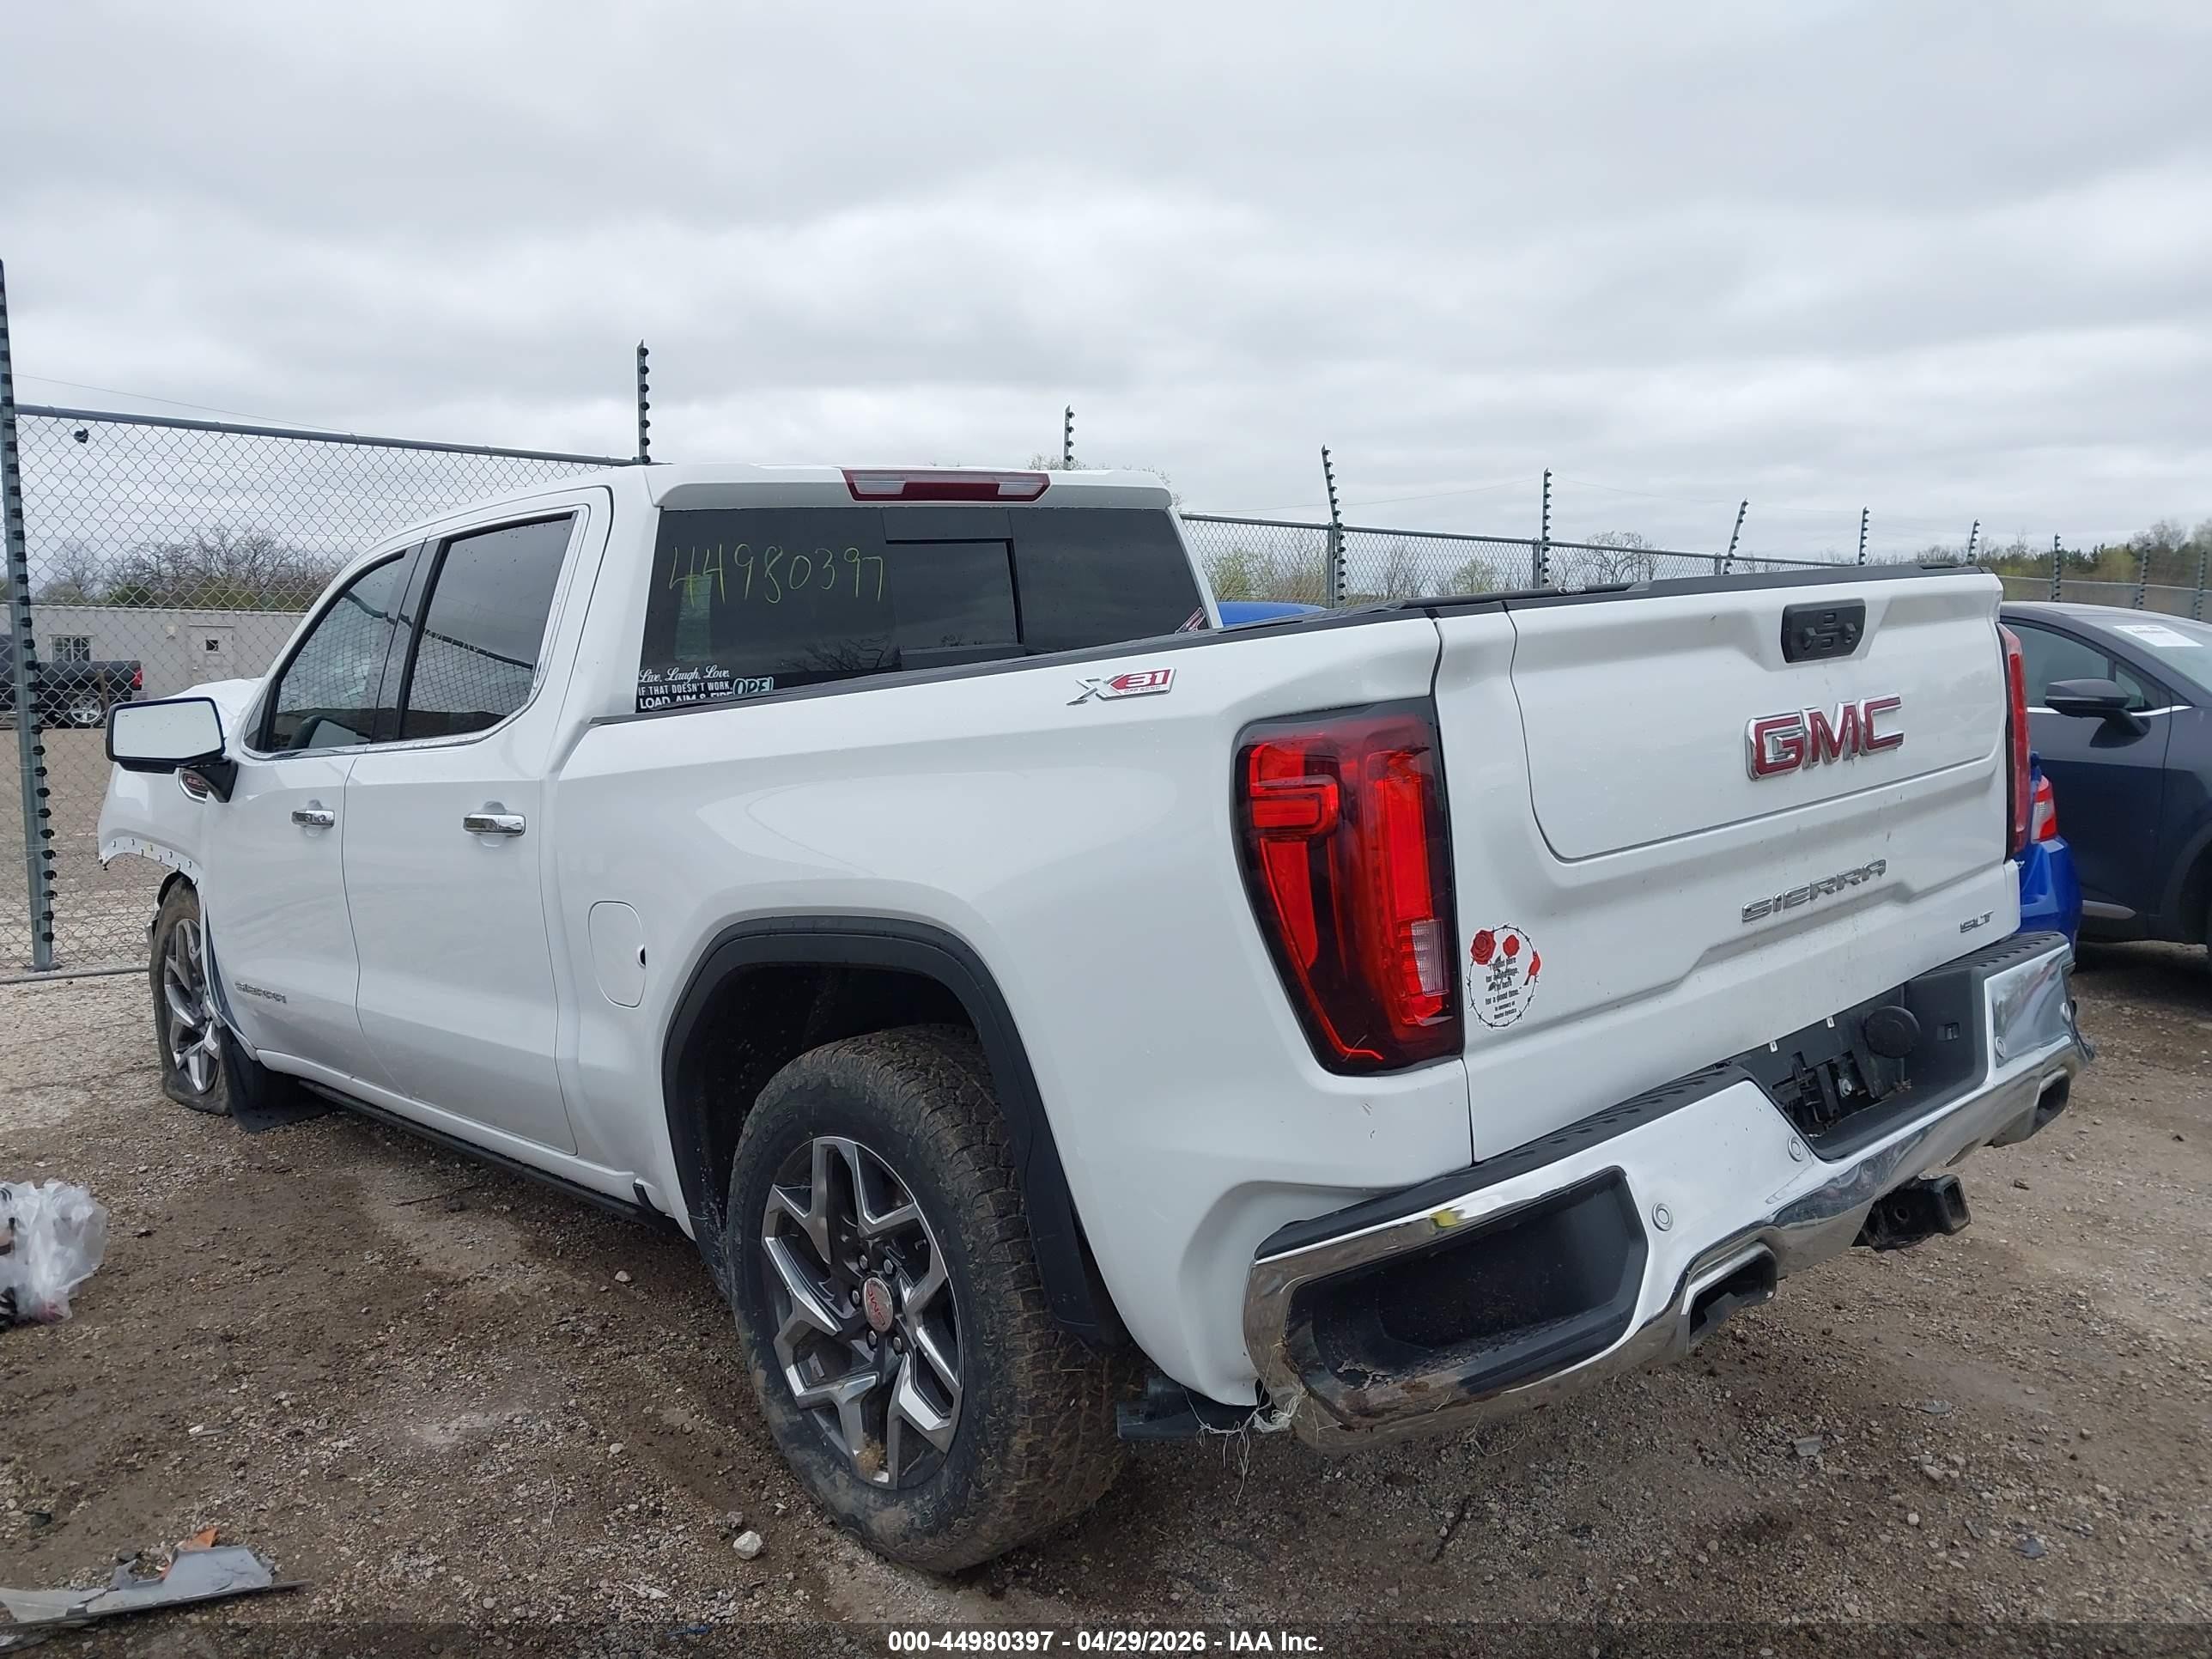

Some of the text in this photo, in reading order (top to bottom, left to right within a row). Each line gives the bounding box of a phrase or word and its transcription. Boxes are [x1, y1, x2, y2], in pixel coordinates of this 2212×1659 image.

[668, 544, 884, 608] 44980397
[639, 687, 647, 696] IF
[649, 685, 669, 696] THAT
[672, 683, 705, 694] DOESN'T
[1745, 693, 1905, 780] GMC
[1741, 859, 1887, 923] SIERRA
[1960, 910, 1995, 933] SLT
